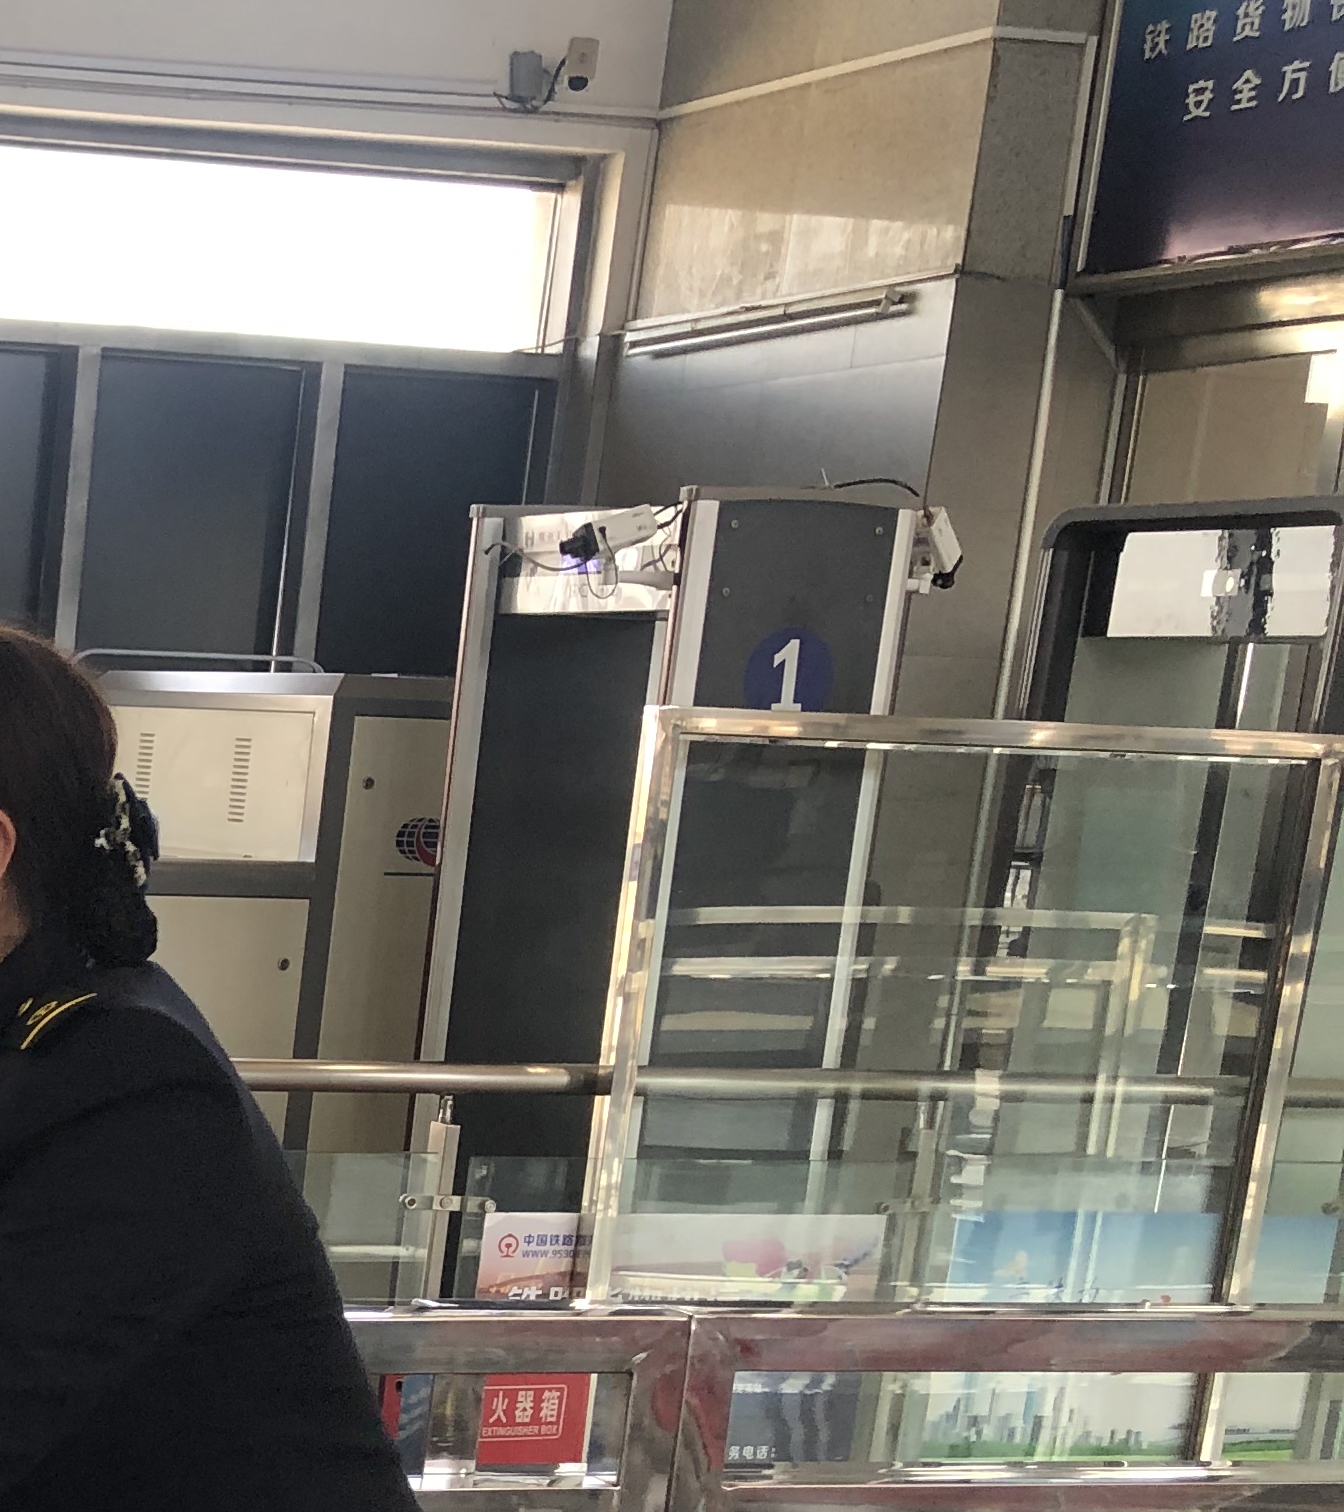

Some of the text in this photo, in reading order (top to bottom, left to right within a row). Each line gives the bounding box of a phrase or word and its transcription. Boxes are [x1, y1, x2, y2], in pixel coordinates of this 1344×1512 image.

[771, 638, 802, 712] 1
[488, 1390, 561, 1424] 火器箱
[482, 1425, 558, 1437] EXTINGUISHER BOX
